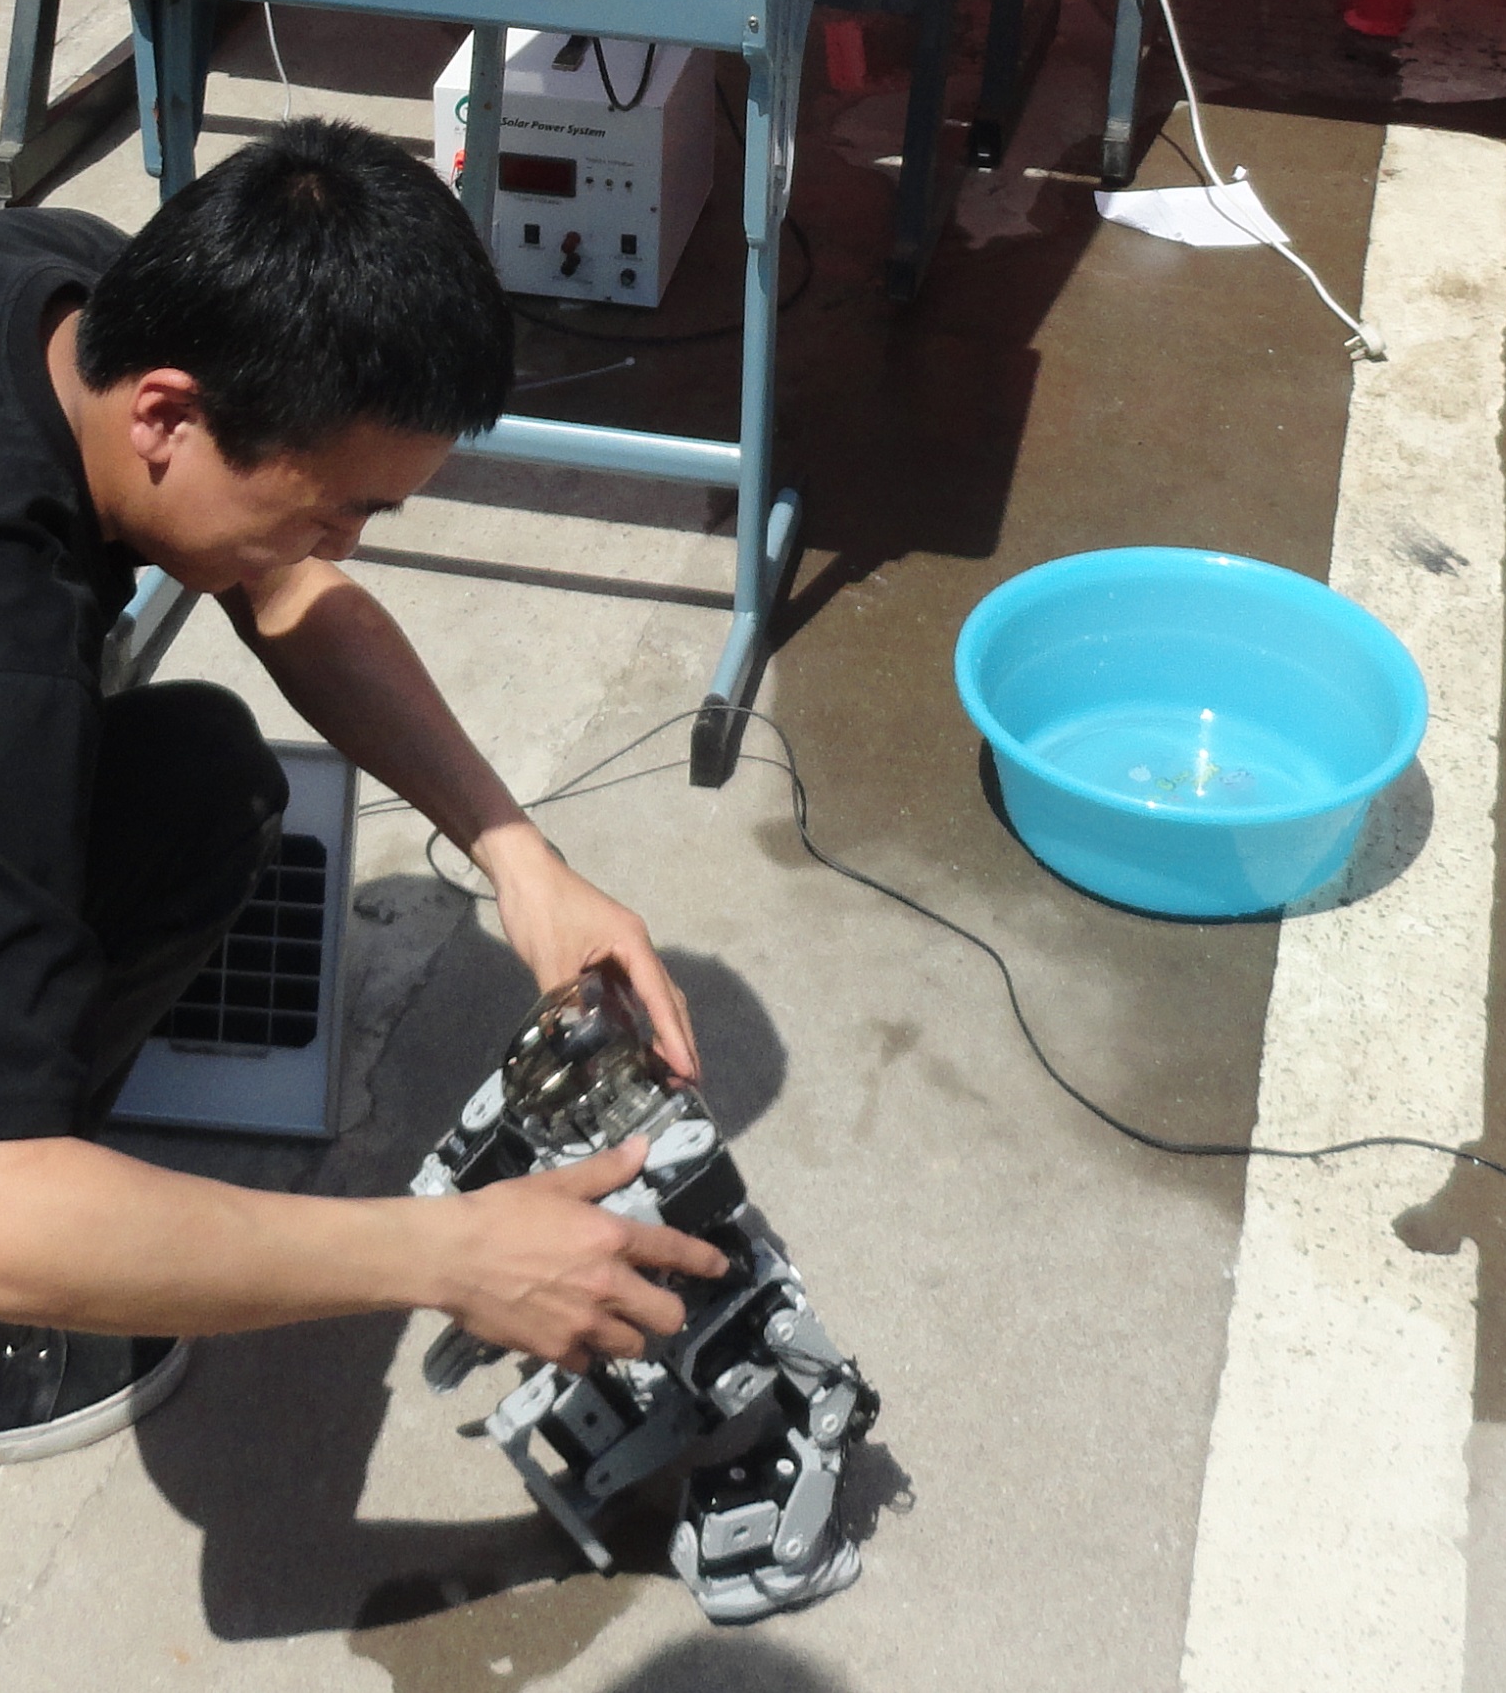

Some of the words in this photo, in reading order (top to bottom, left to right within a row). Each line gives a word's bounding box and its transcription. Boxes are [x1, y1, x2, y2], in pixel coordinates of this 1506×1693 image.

[500, 116, 530, 129] Solar
[531, 120, 565, 133] Power
[567, 124, 606, 138] System
